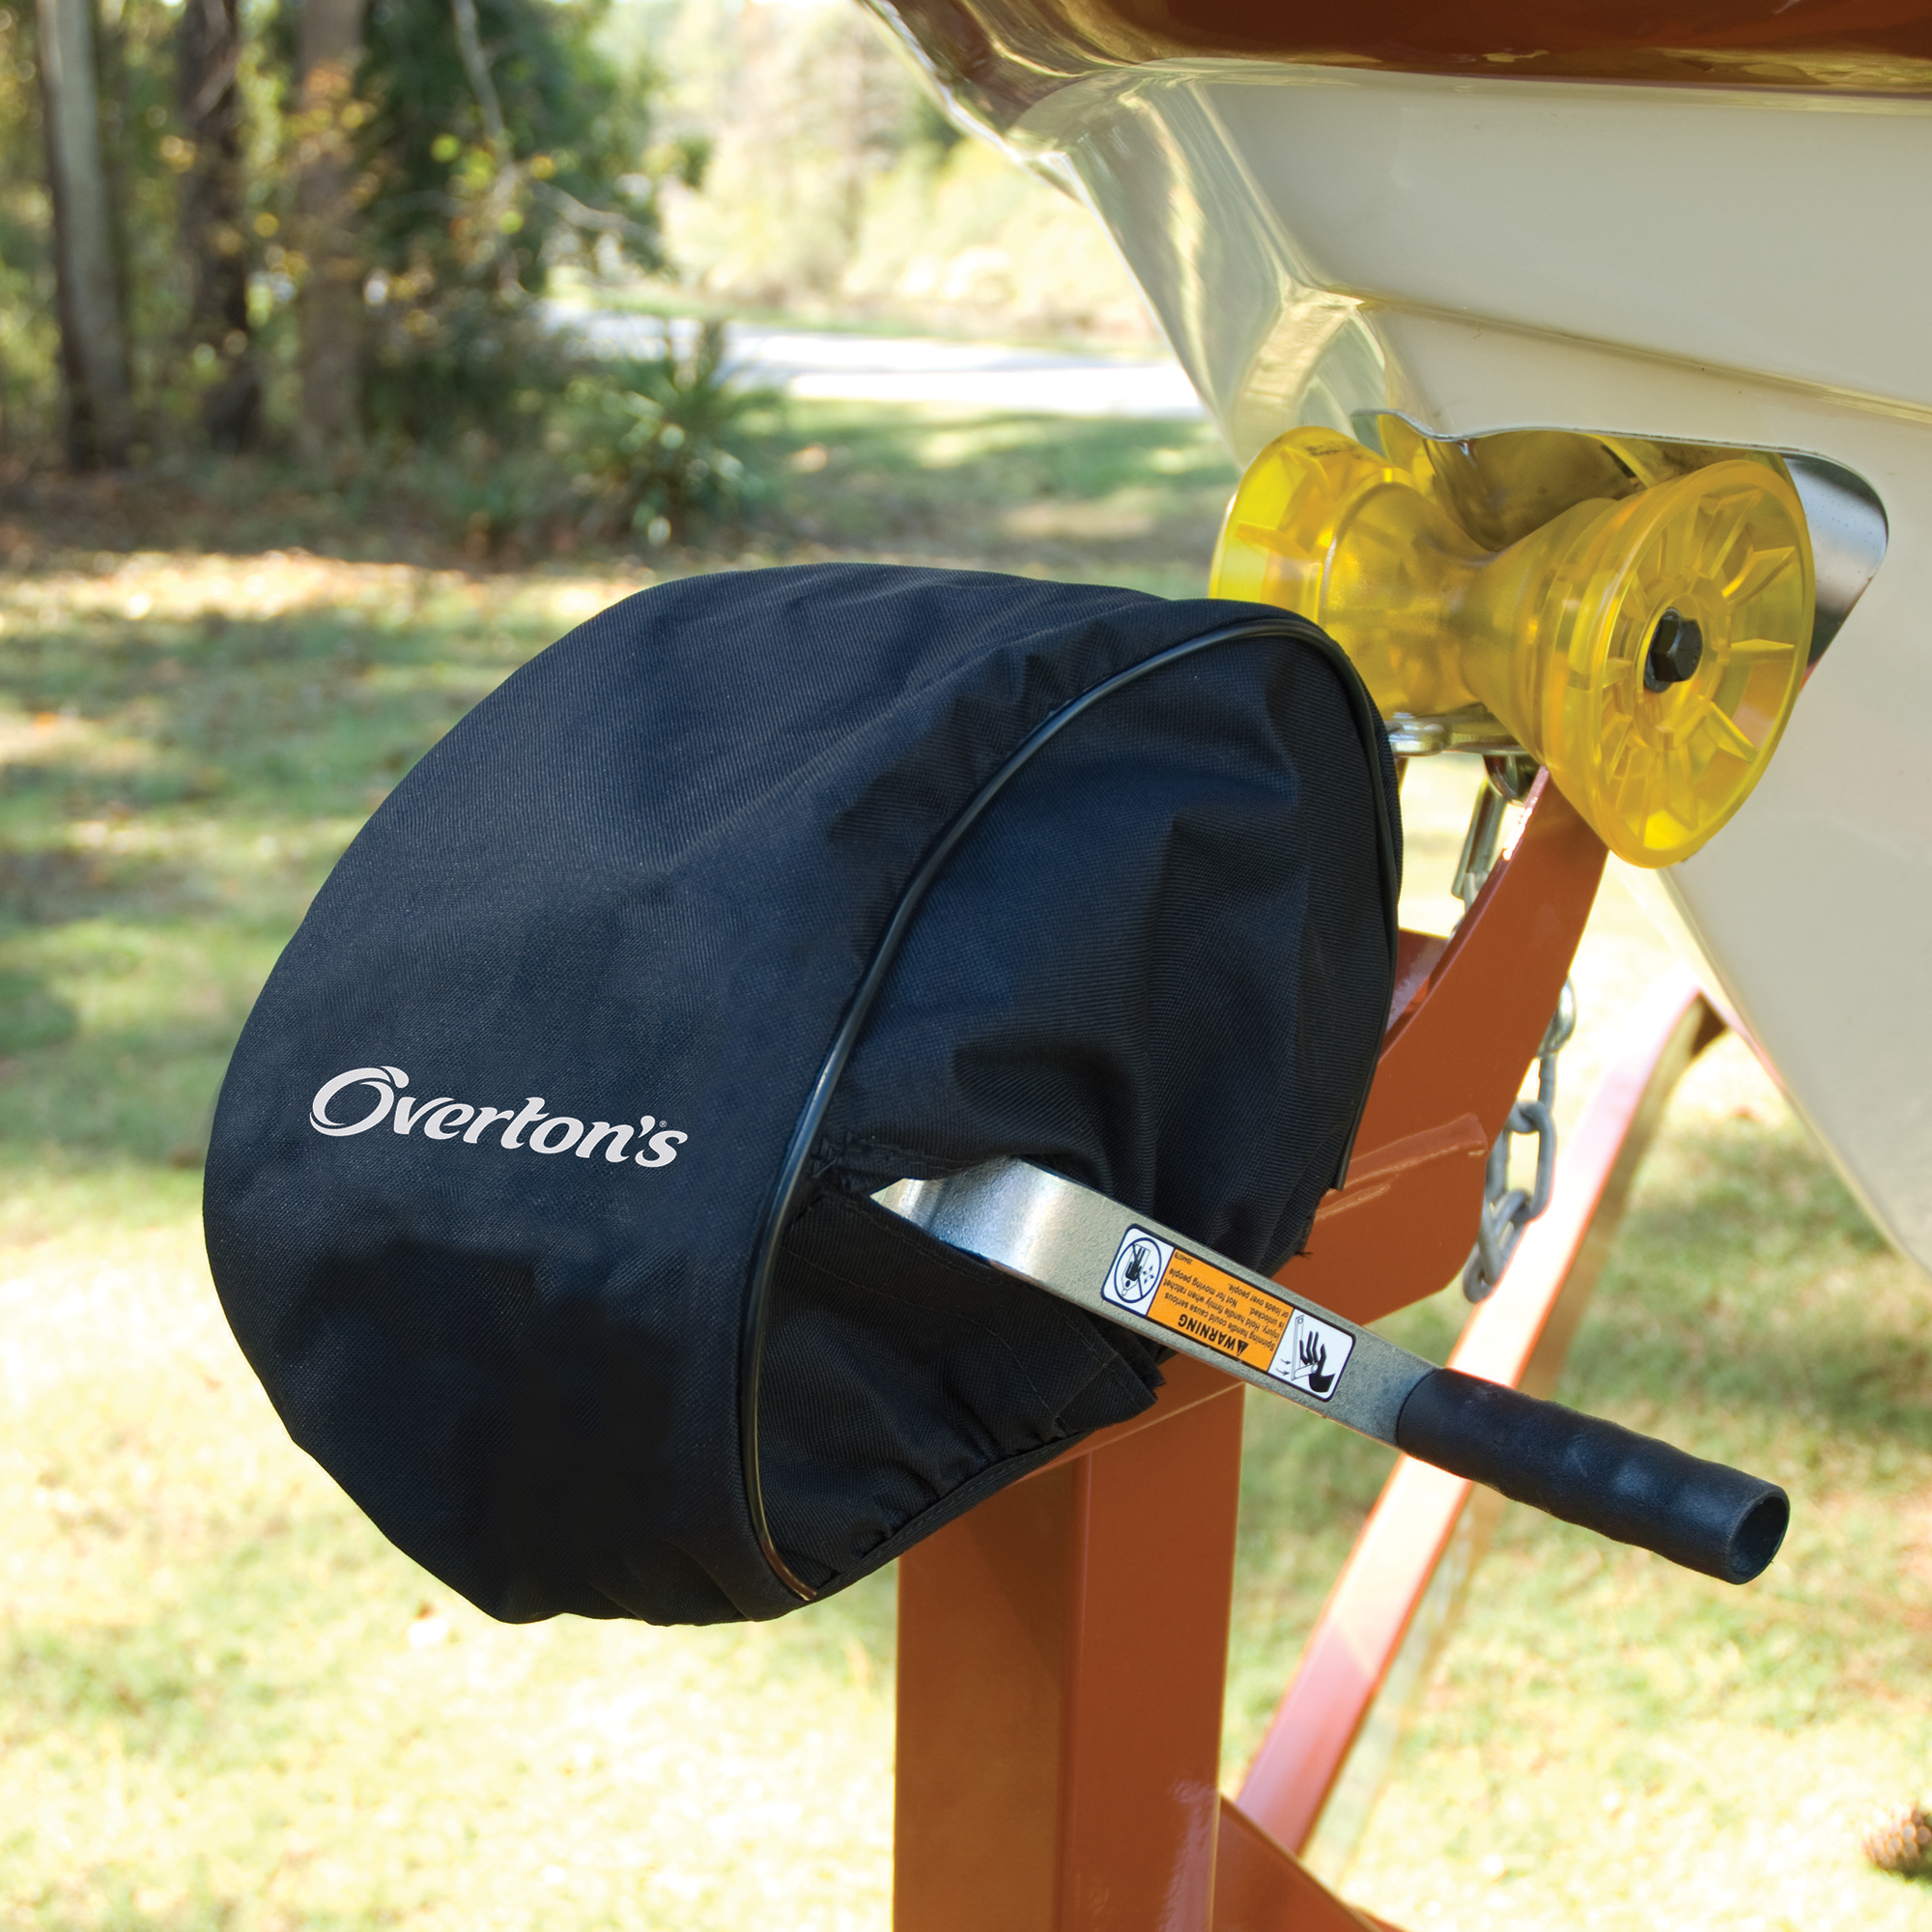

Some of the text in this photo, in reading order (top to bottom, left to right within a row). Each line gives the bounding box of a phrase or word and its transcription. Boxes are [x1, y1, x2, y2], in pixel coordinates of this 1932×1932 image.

[309, 1065, 689, 1168] Overton's
[1168, 1267, 1193, 1284] people
[1162, 1278, 1187, 1294] ratchet
[1191, 1276, 1216, 1295] moving
[1186, 1290, 1206, 1303] when
[1215, 1292, 1227, 1302] for
[1225, 1295, 1238, 1309] Not
[1249, 1294, 1264, 1307] over
[1205, 1296, 1225, 1315] firmly
[1264, 1301, 1282, 1317] loads
[1164, 1292, 1276, 1352] Spinning handle could cause serious
[1224, 1307, 1246, 1324] handle
[1177, 1313, 1237, 1351] WARNING
[1244, 1318, 1262, 1332] Hold
